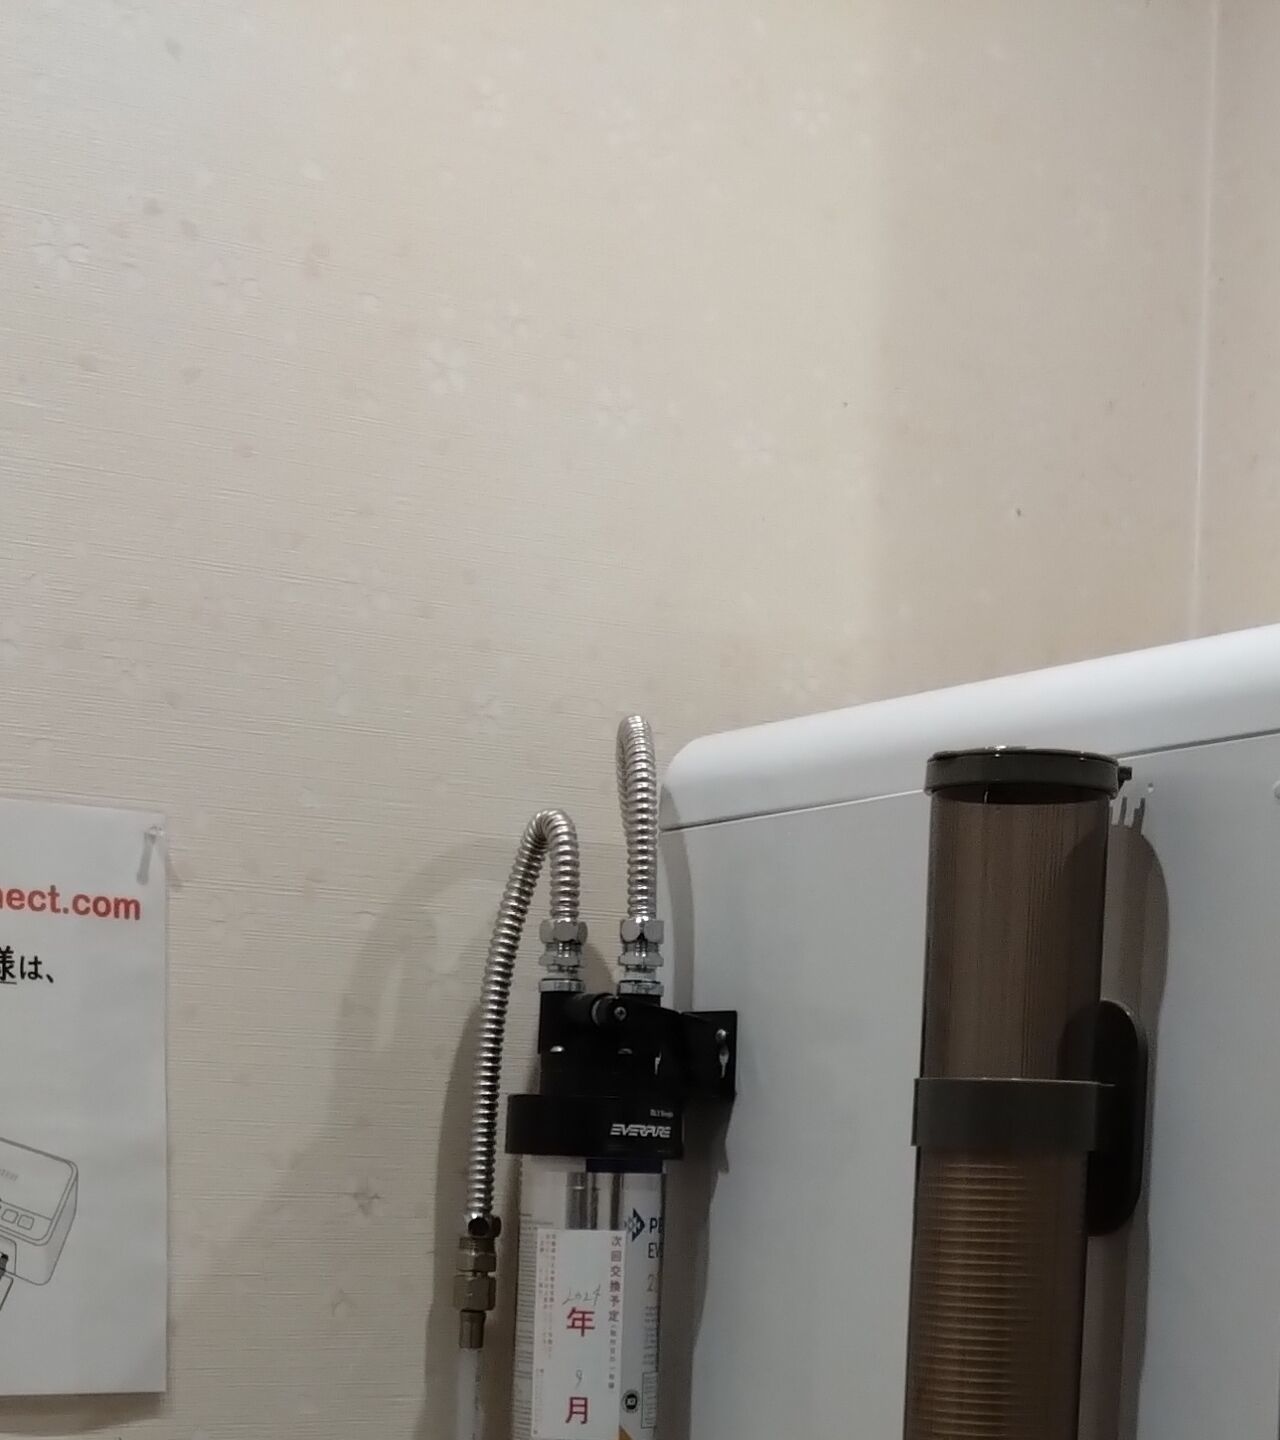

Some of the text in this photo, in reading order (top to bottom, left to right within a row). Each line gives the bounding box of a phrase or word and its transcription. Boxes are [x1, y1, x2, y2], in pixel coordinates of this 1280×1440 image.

[610, 1122, 672, 1139] EVERPURE
[565, 1306, 596, 1337] 年
[564, 1396, 589, 1425] 月
